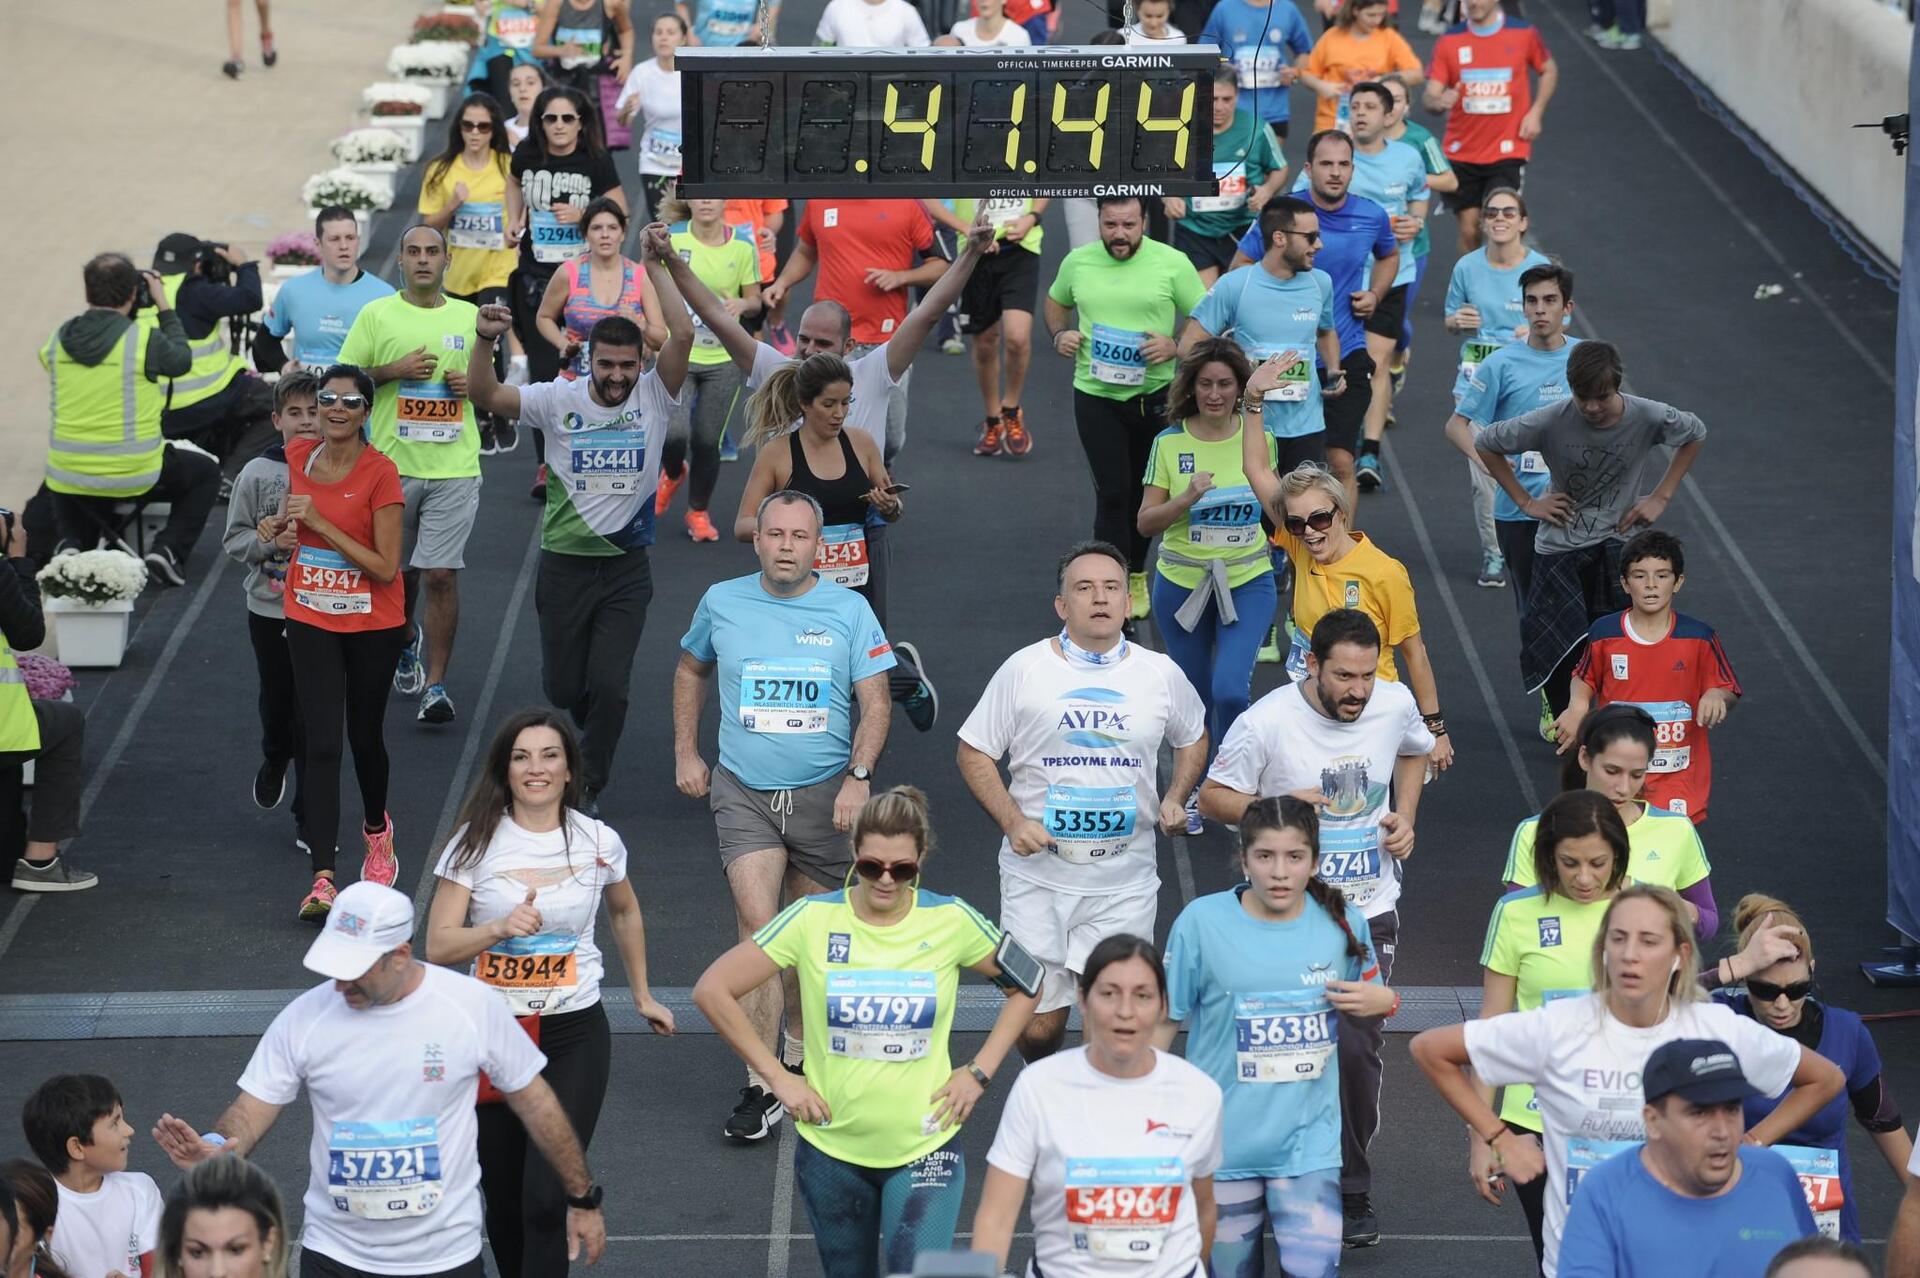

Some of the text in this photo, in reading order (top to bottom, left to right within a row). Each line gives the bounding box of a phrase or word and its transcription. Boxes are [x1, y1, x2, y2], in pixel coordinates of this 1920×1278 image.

[997, 60, 1039, 69] OFFICIAL
[1042, 60, 1098, 68] TIMEKEEPER
[989, 188, 1032, 197] OFFICIAL
[1034, 188, 1089, 197] TIMEKEEPER
[1094, 340, 1142, 362] 52606
[403, 400, 458, 417] 59230
[581, 449, 638, 469] 56441
[1199, 503, 1254, 521] 52179
[302, 566, 362, 589] 54947
[795, 634, 833, 647] WIND
[752, 680, 819, 702] 52710
[1042, 757, 1107, 767] ΤΡΕΧΟΥΜΕ
[1053, 809, 1126, 832] 53552
[1315, 851, 1371, 877] 6741
[485, 955, 567, 980] 58944
[838, 996, 927, 1024] 56797
[1249, 1012, 1329, 1046] 56381
[341, 1147, 425, 1180] 57321
[1076, 1187, 1173, 1218] 54964
